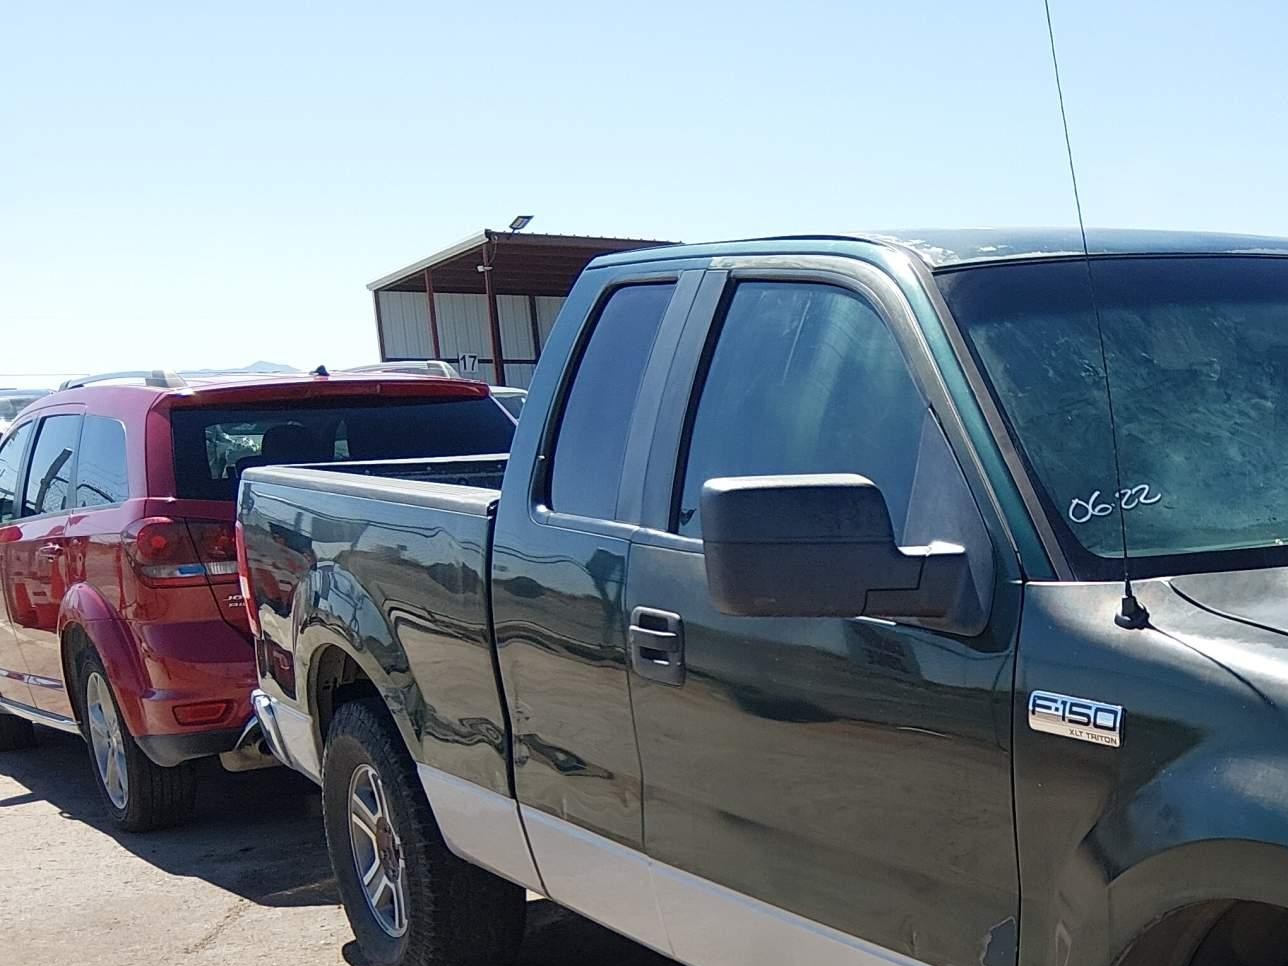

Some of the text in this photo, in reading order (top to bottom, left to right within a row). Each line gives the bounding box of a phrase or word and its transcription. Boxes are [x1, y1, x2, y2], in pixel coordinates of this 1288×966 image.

[460, 355, 477, 371] 17
[1069, 728, 1118, 745] XLT TRITON
